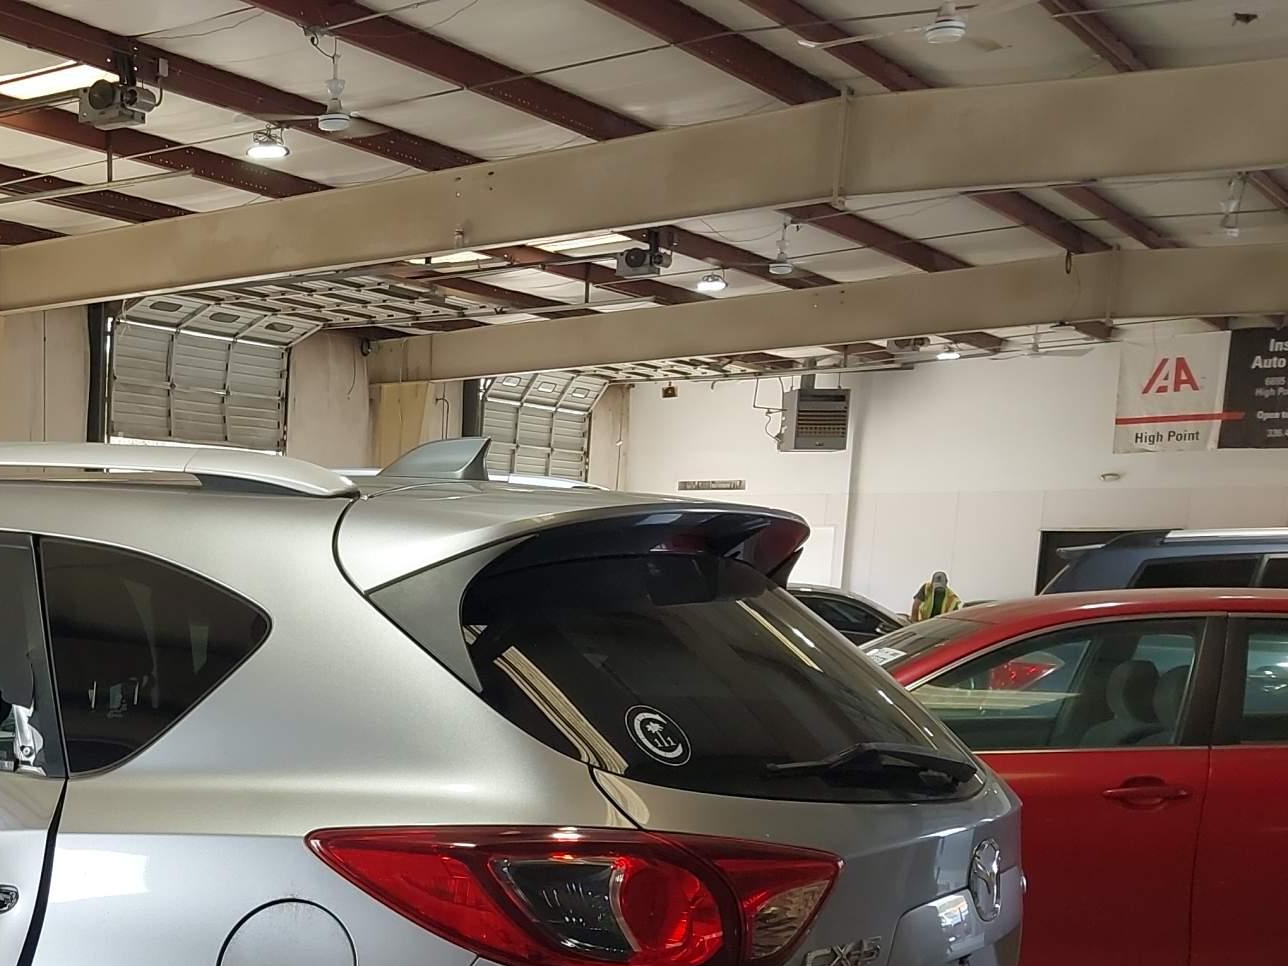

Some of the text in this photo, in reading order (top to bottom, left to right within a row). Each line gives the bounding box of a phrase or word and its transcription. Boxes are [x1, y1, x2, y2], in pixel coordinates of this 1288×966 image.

[1251, 355, 1286, 369] Auto
[1135, 430, 1200, 445] High Point
